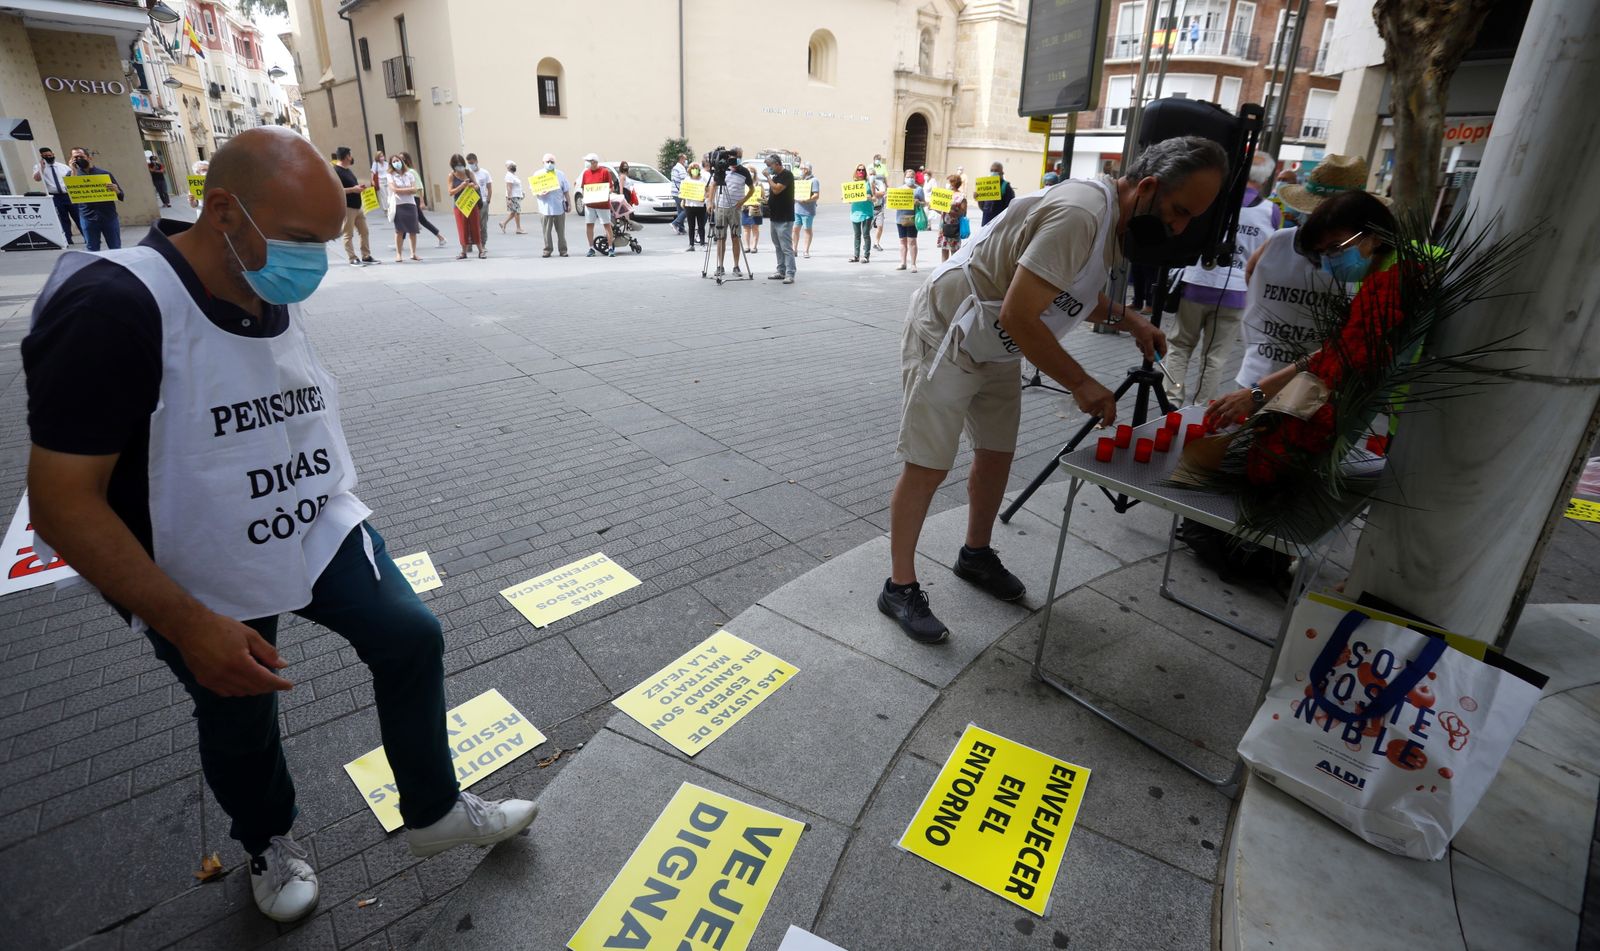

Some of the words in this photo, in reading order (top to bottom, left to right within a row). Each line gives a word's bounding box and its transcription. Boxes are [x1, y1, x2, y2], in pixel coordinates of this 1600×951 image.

[45, 76, 125, 96] OYSHO
[843, 183, 864, 191] VEJEZ
[931, 190, 952, 199] PENSIONES
[933, 199, 948, 207] DIGNAS
[507, 556, 607, 600] DEPENDENCIA
[535, 574, 615, 611] RECURSOS
[557, 578, 579, 591] EN
[687, 653, 709, 667] LA
[706, 645, 719, 654] A
[741, 648, 763, 664] EN
[641, 667, 690, 699] VEJEZ
[659, 654, 731, 705] MALTRATO
[684, 663, 743, 706] SANIDAD
[757, 668, 785, 690] LAS
[695, 675, 752, 715] ESPERA
[710, 688, 760, 726] LISTAS
[650, 705, 685, 731] SON
[687, 725, 713, 745] DE
[1315, 759, 1366, 789] ALDI
[925, 740, 997, 847] ENTORNO
[993, 774, 1026, 809] EN
[977, 806, 1012, 835] EL
[1004, 764, 1077, 900] ENVEJECER
[602, 801, 729, 950] DIGNA
